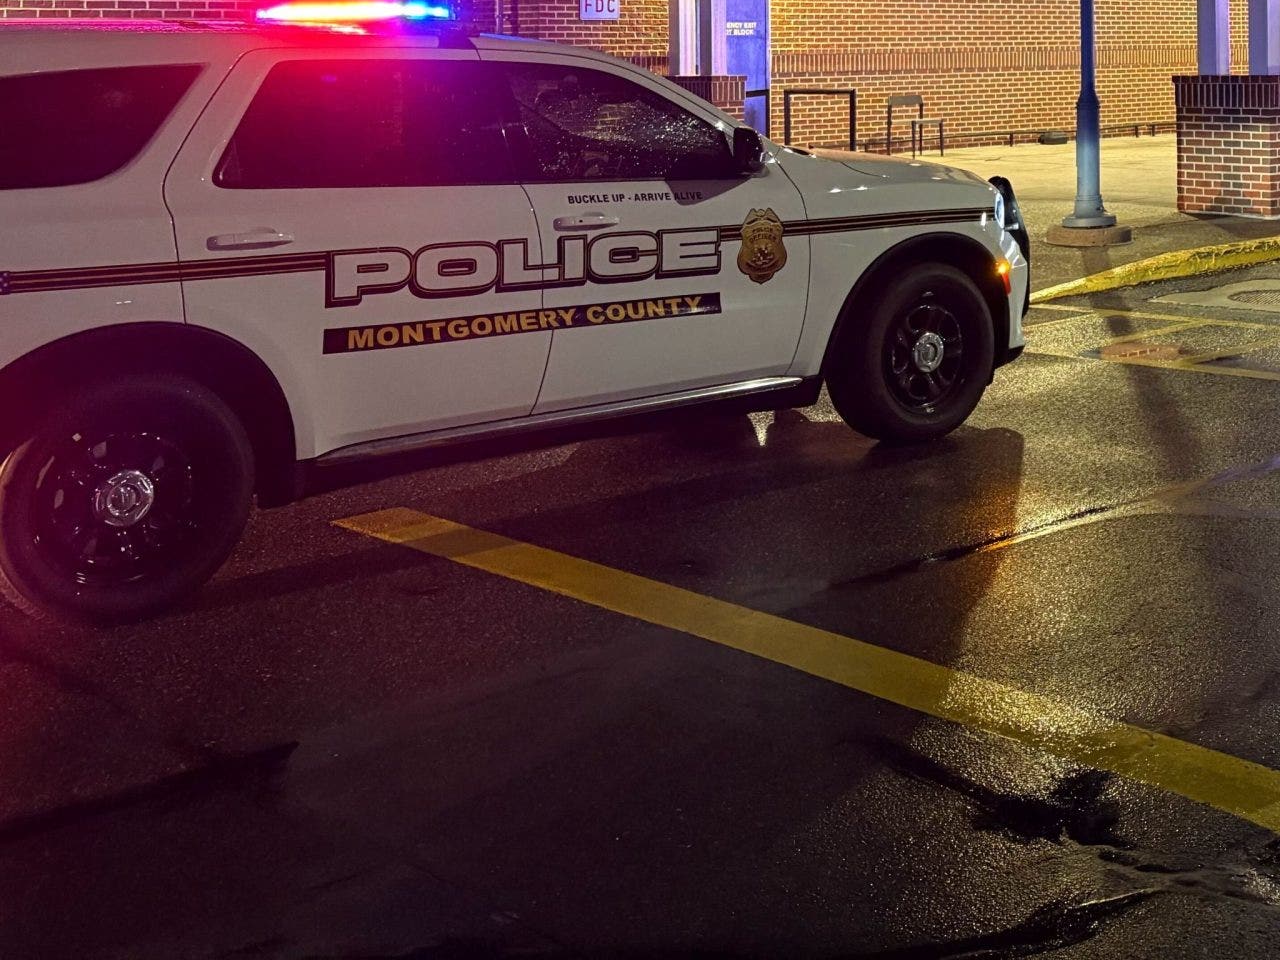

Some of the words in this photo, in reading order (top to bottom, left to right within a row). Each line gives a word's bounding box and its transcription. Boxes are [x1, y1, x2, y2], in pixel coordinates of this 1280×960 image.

[567, 194, 610, 204] BUCKLE
[611, 193, 625, 203] UP
[634, 192, 671, 202] ARRIVE
[674, 191, 703, 201] ALIVE
[325, 228, 721, 308] POLICE
[346, 307, 577, 350] MONTGOMERY
[586, 295, 703, 324] COUNTY
